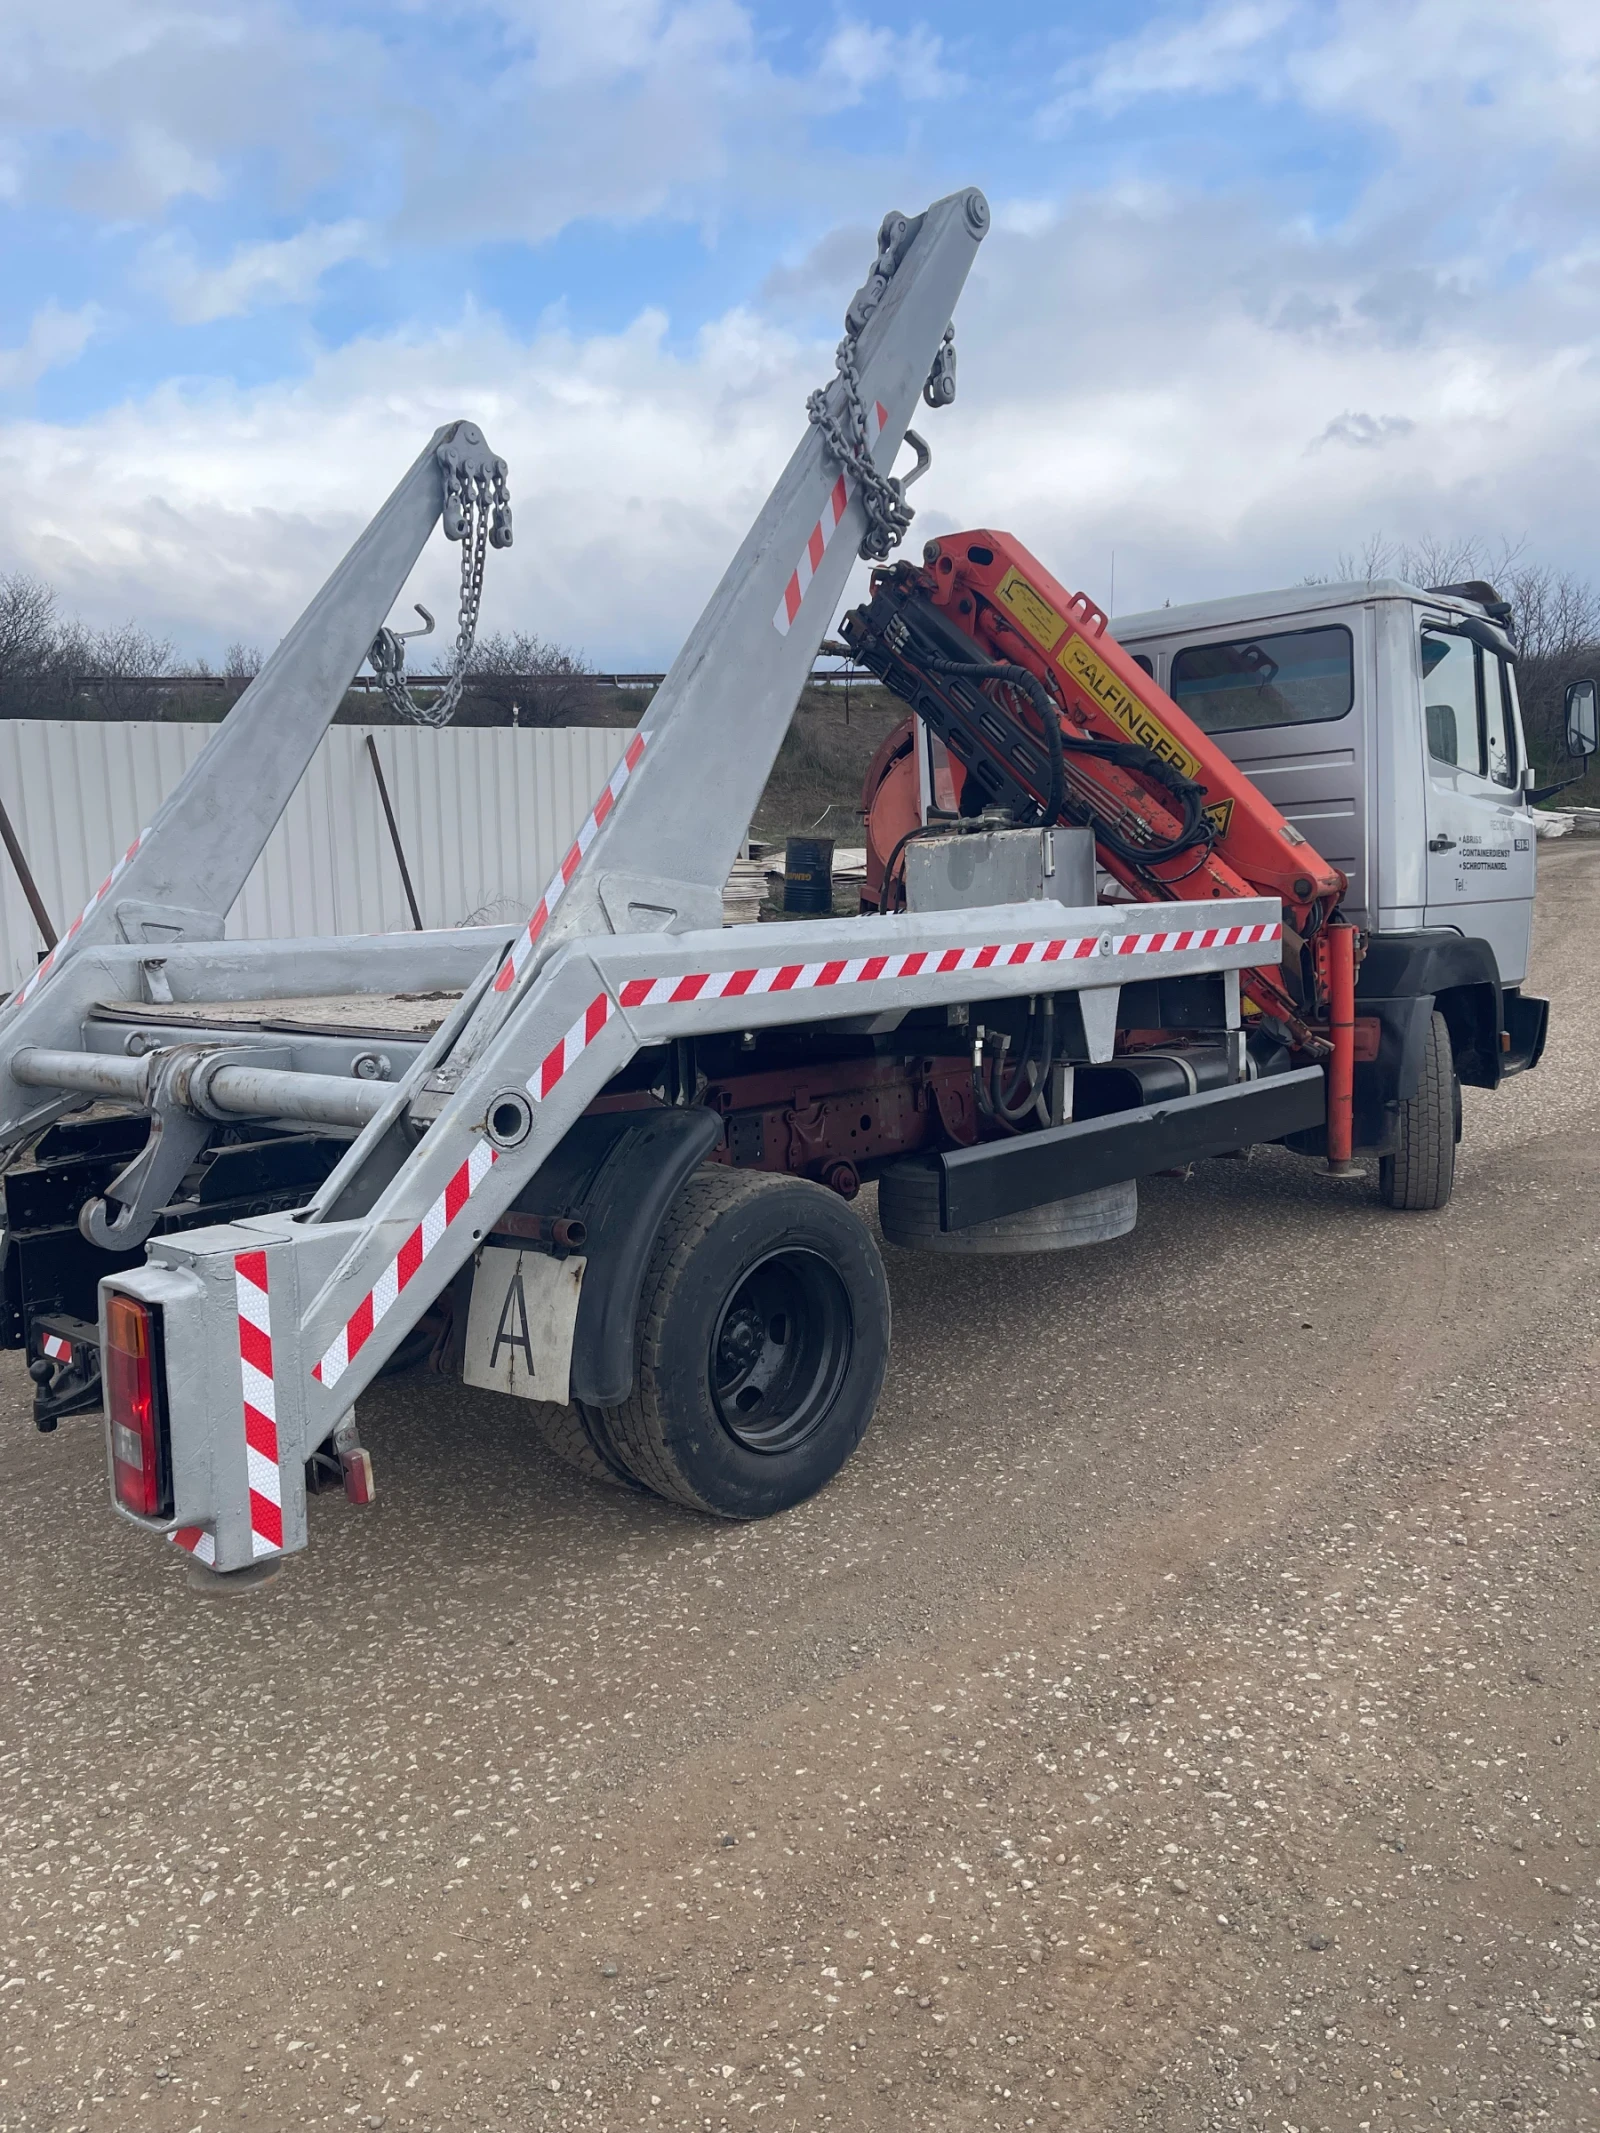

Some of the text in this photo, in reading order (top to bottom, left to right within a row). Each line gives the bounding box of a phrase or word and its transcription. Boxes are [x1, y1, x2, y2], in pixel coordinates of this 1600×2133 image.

[1463, 835, 1482, 844] ABRISS
[1516, 840, 1528, 850] 914
[1463, 849, 1510, 857] CONTAINERDIENST
[1463, 862, 1507, 870] SCHROTTHANDEL
[489, 1274, 536, 1377] A
